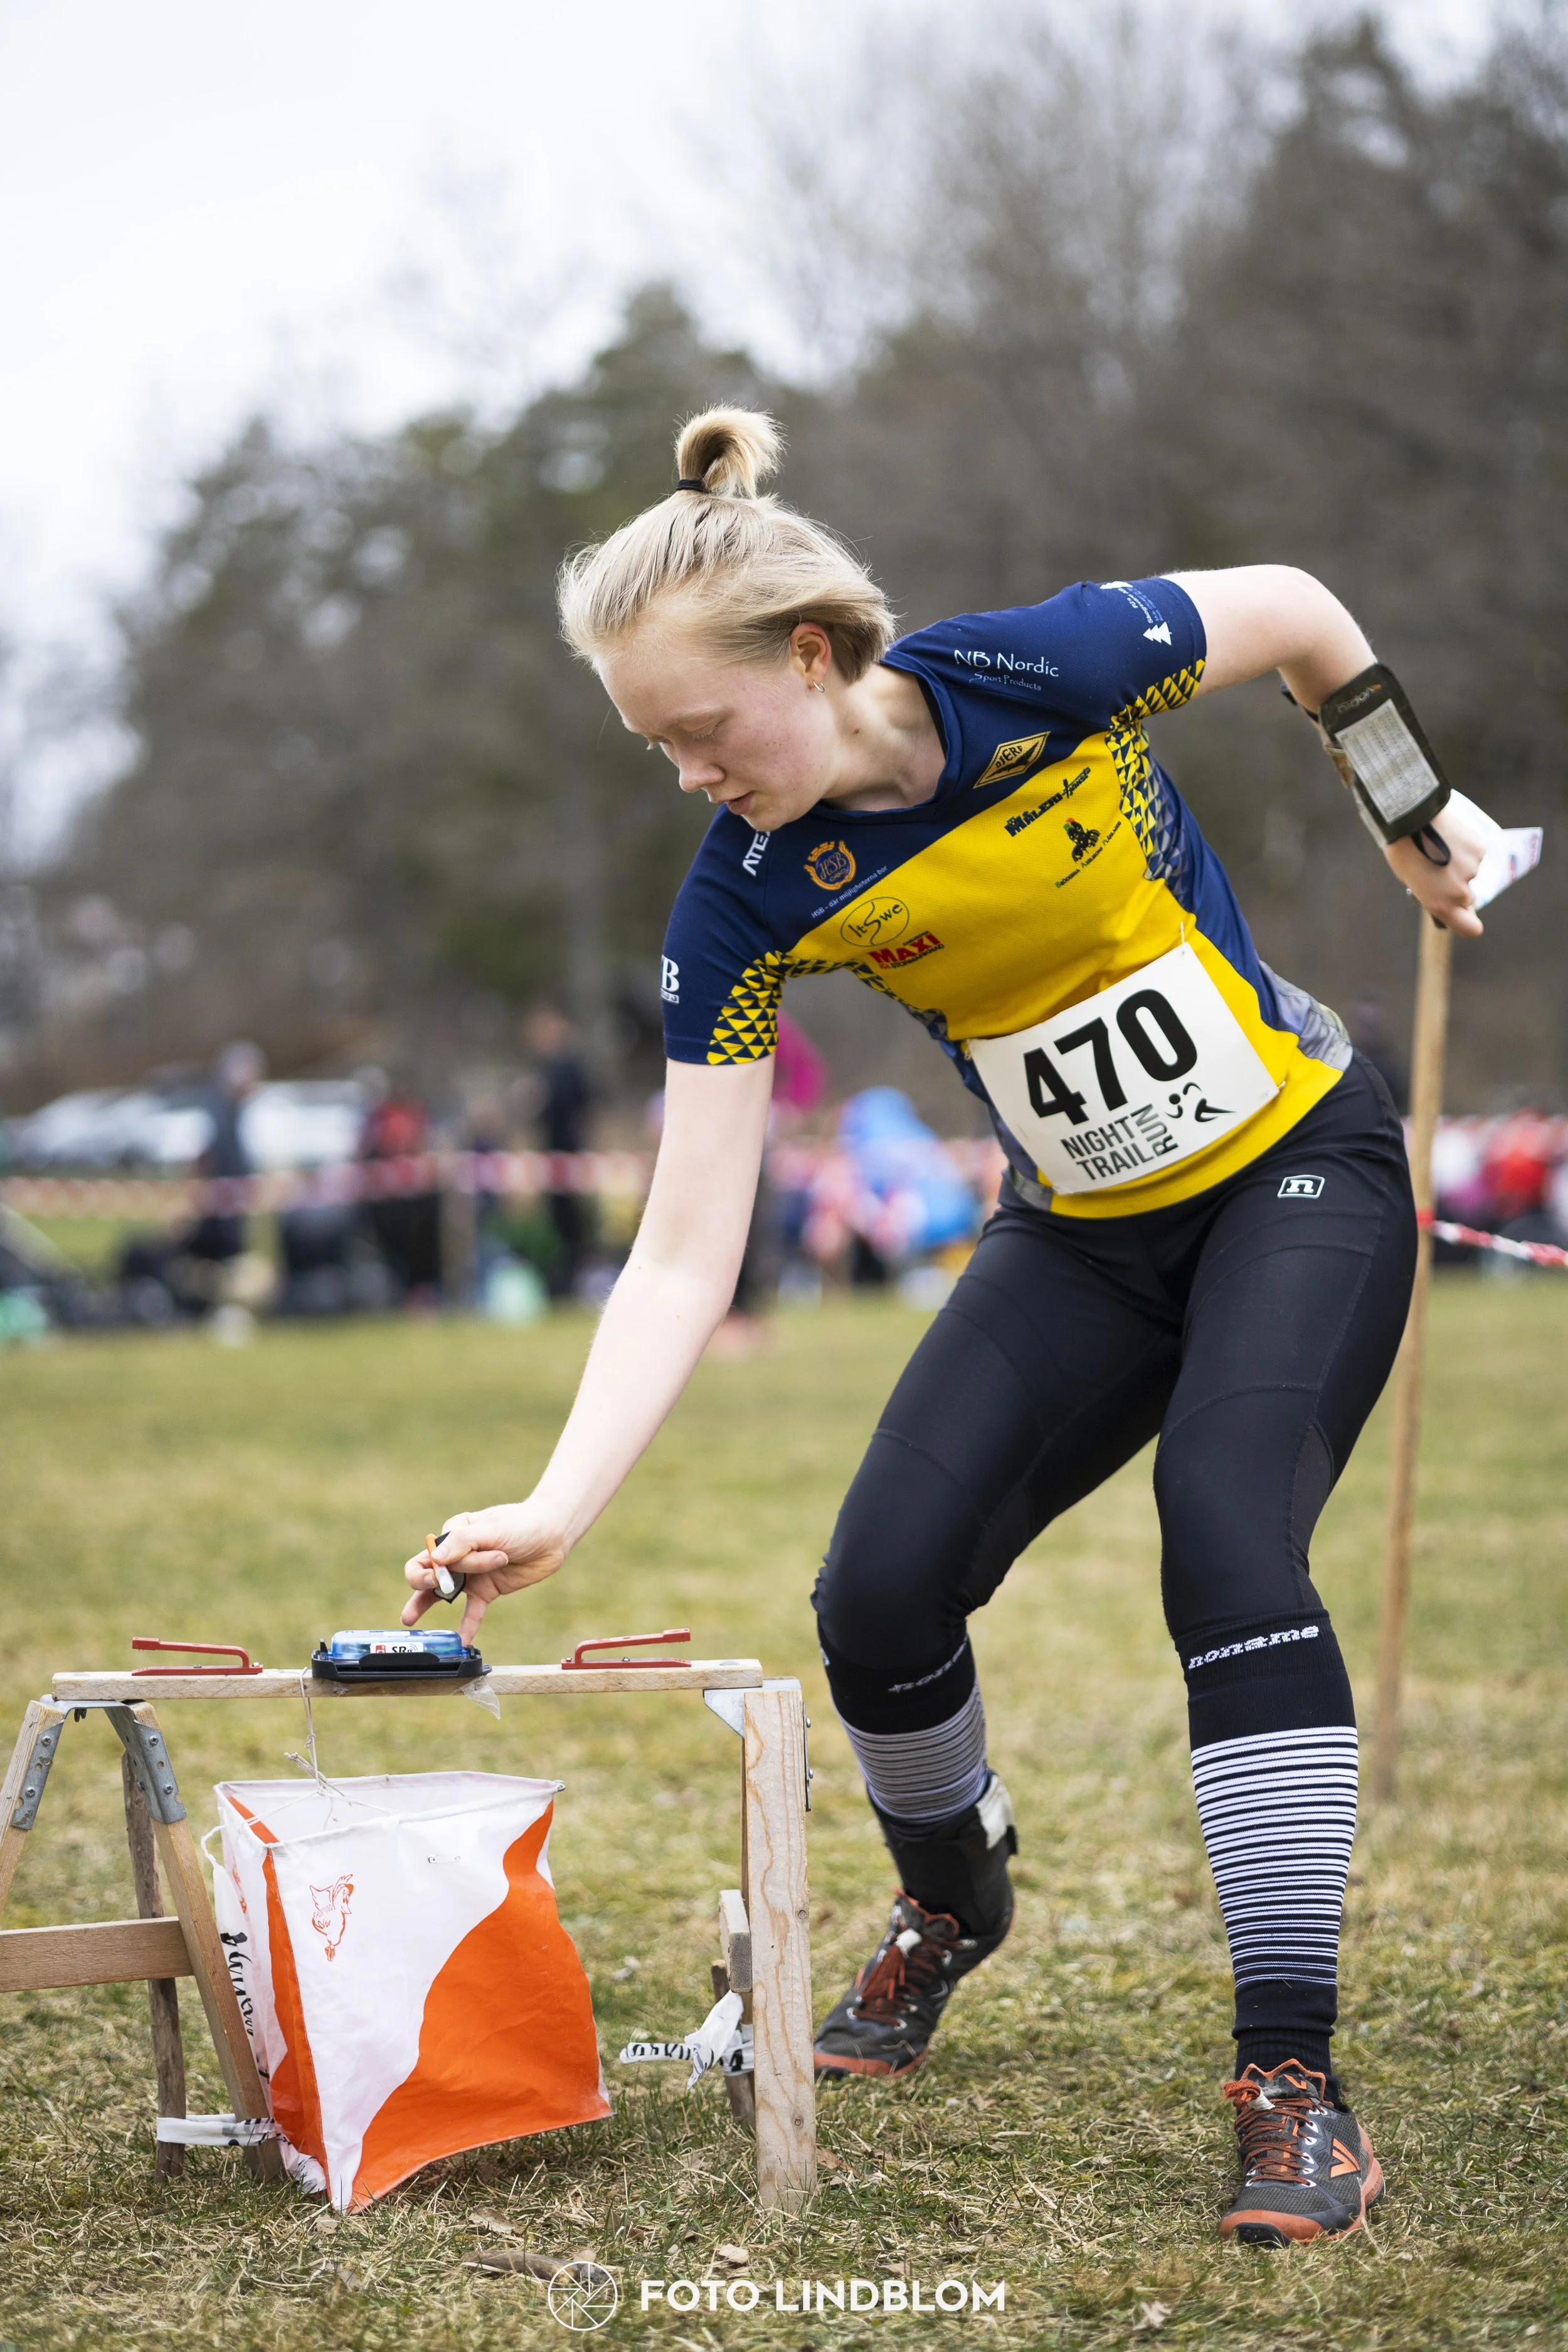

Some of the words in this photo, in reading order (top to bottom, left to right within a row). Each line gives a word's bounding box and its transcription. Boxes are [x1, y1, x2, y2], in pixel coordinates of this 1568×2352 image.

[954, 649, 991, 668] NB
[997, 652, 1059, 677] Nordic
[969, 670, 1002, 683] Sport
[1004, 674, 1042, 691] Products
[742, 830, 771, 877] ATE
[811, 906, 825, 918] HSB
[829, 898, 840, 908] där
[839, 872, 878, 901] möjligheterna
[877, 865, 888, 876] bor
[867, 933, 942, 964] MAXI
[1023, 989, 1198, 1126] 470
[1060, 1115, 1135, 1159] NIGHT
[1130, 1103, 1179, 1157] RUN
[1076, 1142, 1155, 1180] TRAIL
[1189, 1625, 1320, 1670] noname
